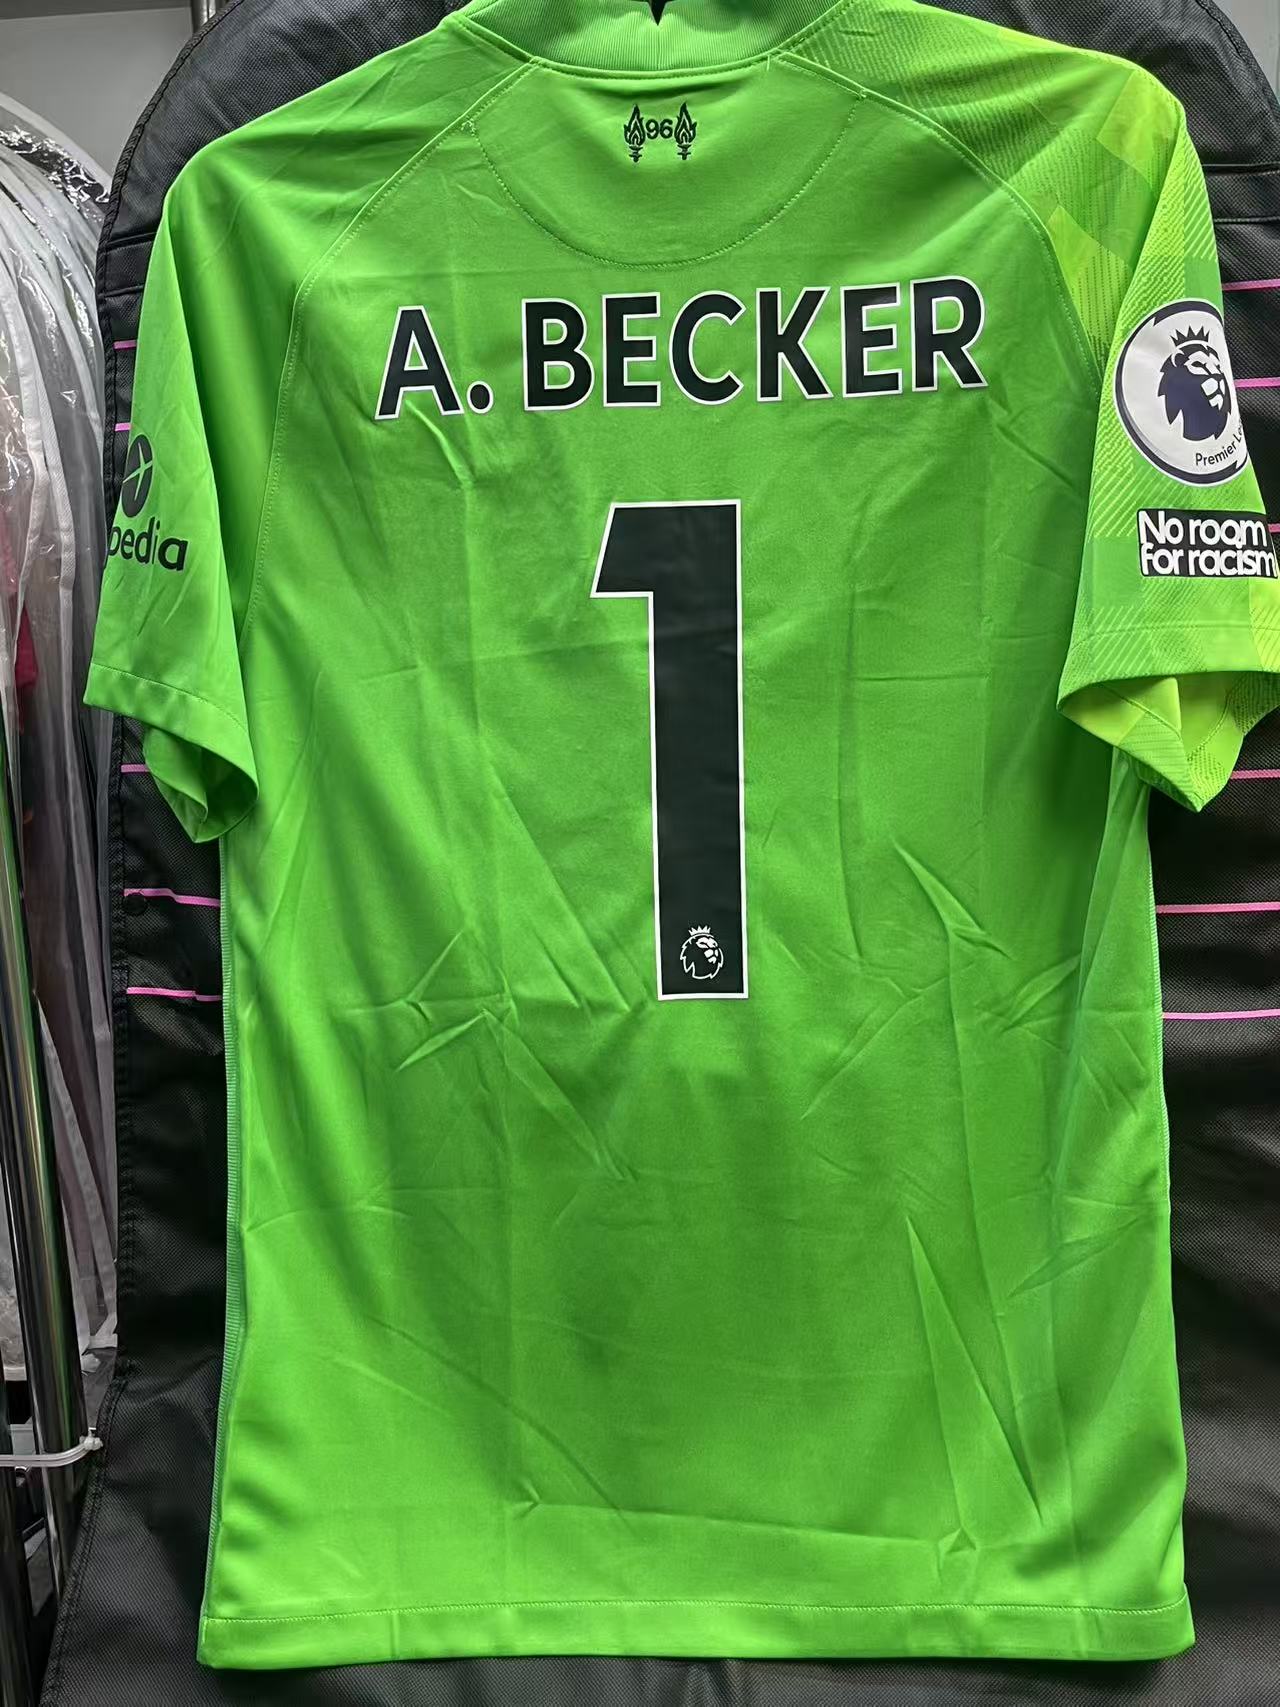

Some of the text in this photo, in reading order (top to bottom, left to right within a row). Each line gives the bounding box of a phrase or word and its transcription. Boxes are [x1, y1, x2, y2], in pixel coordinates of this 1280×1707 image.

[645, 118, 674, 140] 96
[374, 275, 989, 420] A. BECKER
[1195, 440, 1238, 467] Premier
[1138, 510, 1268, 549] No room
[1187, 548, 1278, 578] racism
[590, 499, 749, 1000] 1
